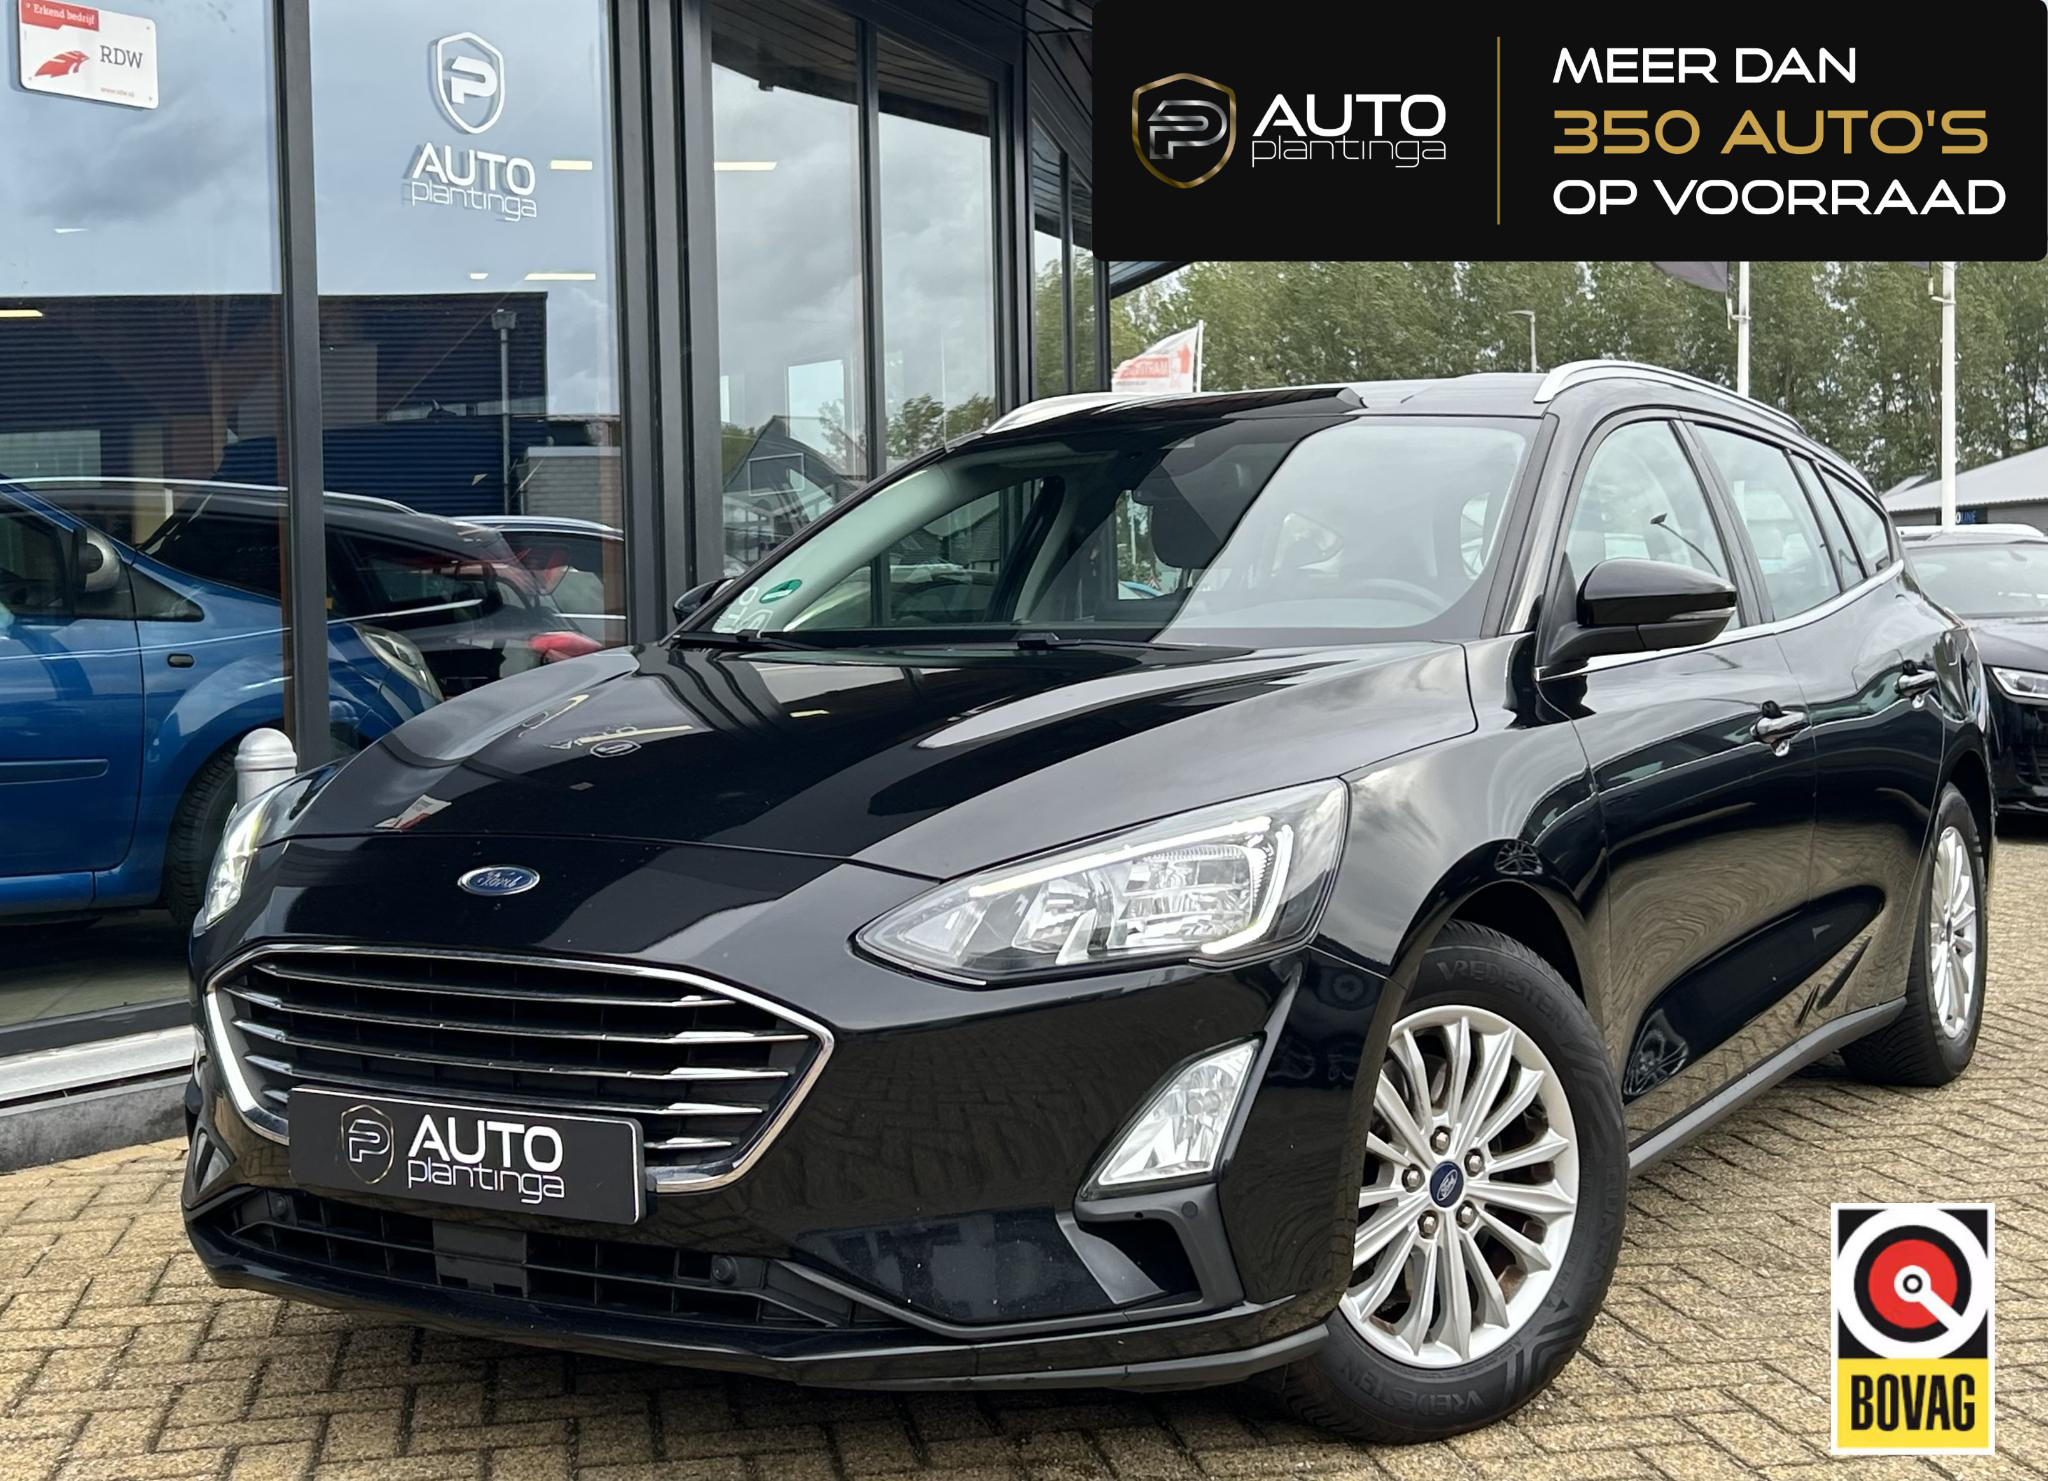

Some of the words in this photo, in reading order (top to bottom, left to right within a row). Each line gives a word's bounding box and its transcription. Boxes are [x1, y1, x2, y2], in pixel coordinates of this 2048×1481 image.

[33, 4, 65, 18] Erkend
[66, 9, 95, 25] bedrijf
[100, 45, 143, 69] RDW
[412, 142, 536, 196] AUTO
[411, 180, 537, 222] plantinga
[407, 1114, 563, 1172] AUTO
[407, 1157, 565, 1204] plantinga
